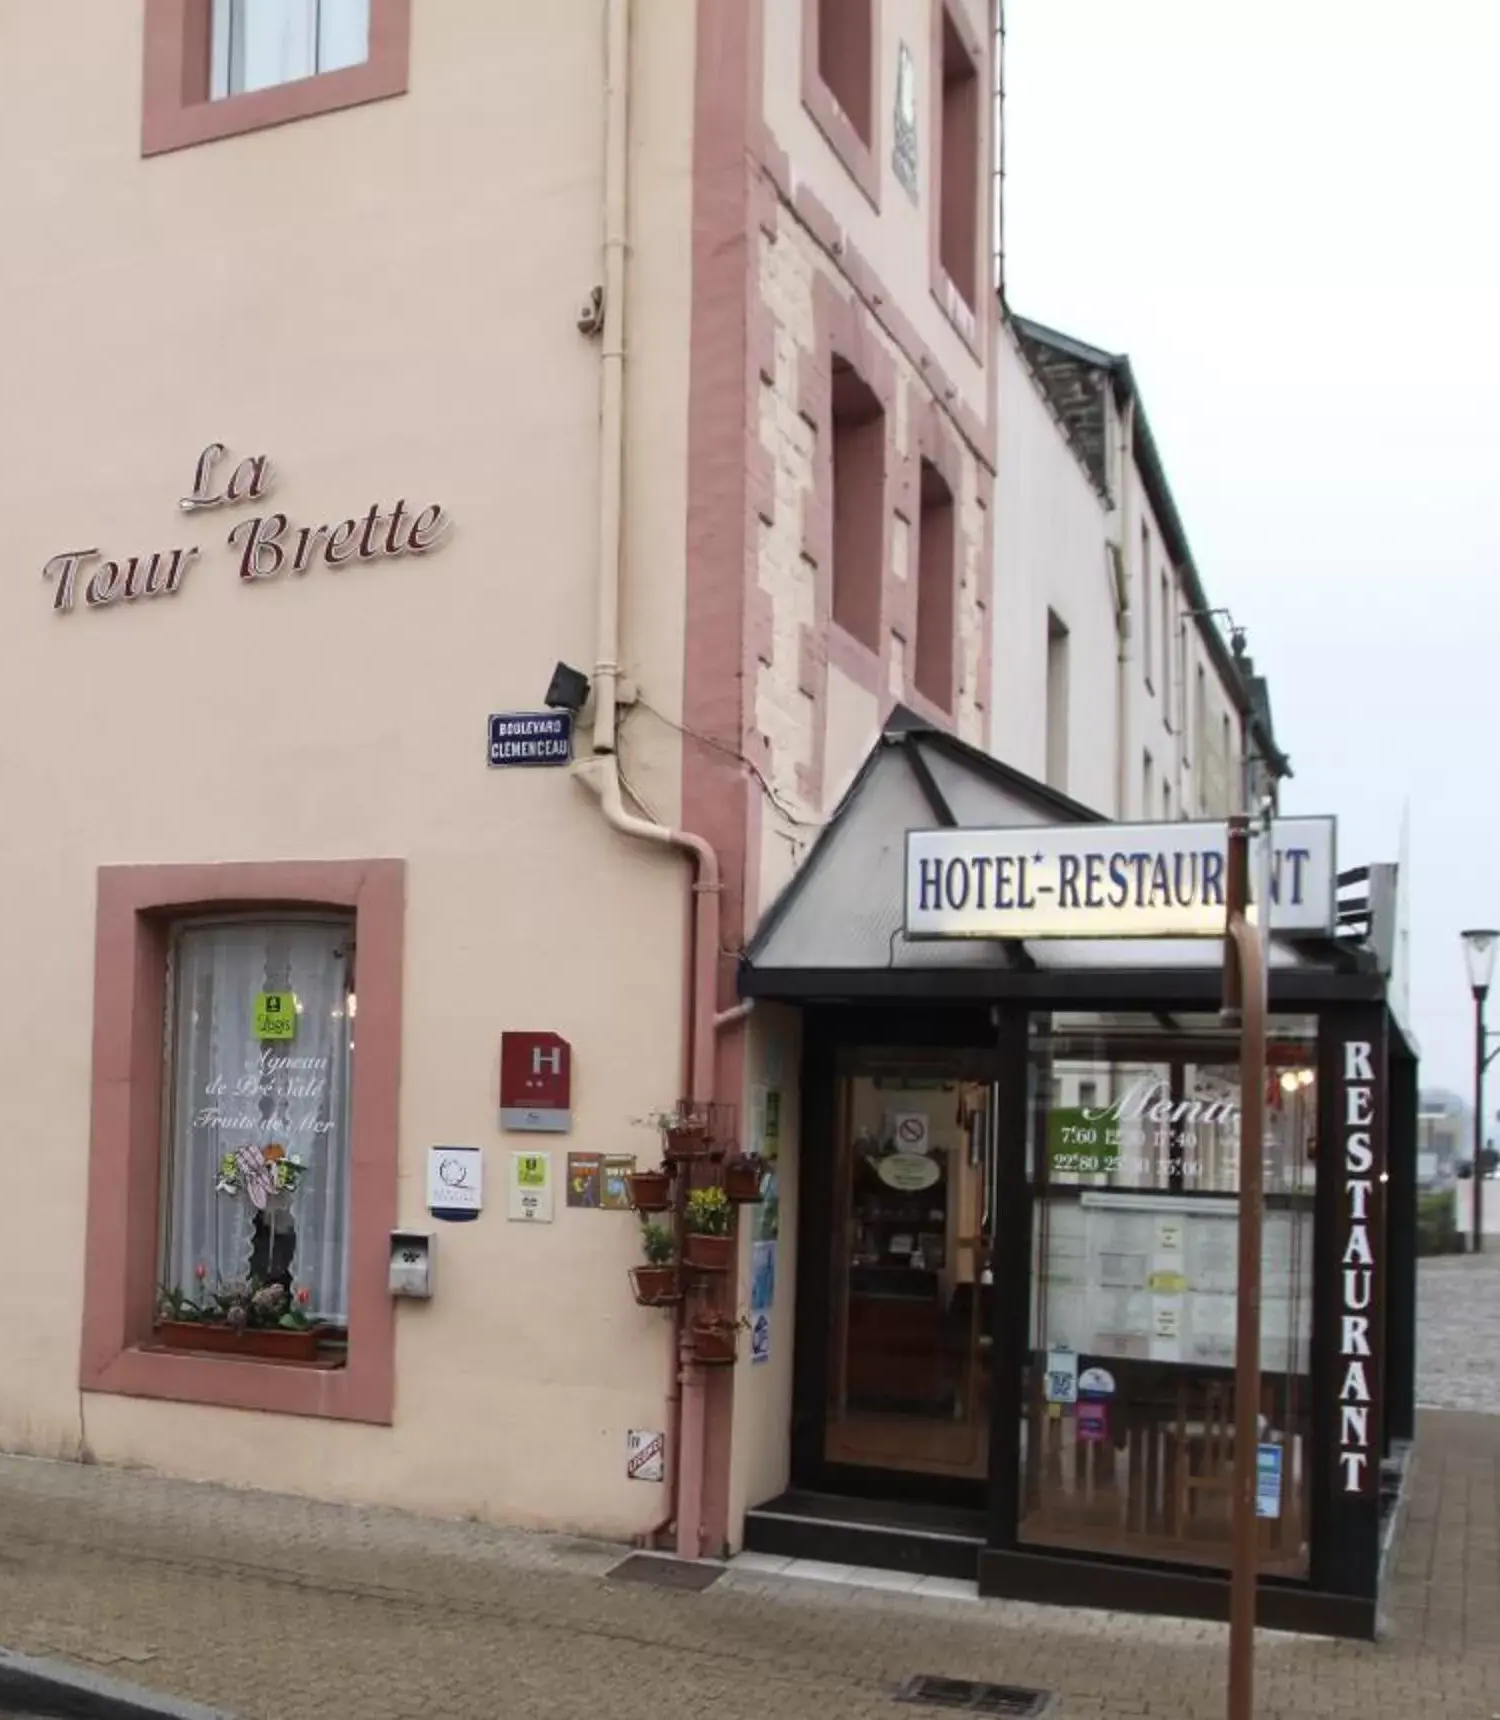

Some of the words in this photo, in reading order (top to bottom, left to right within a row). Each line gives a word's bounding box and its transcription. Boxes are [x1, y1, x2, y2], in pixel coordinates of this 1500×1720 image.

[177, 442, 272, 513] La
[42, 547, 200, 615] Tour
[227, 498, 450, 583] Brette
[499, 720, 562, 736] BOULEVARD
[491, 738, 568, 758] CLEMENCEAU
[918, 848, 1311, 911] HOTEL-RESTAURNT
[532, 1047, 561, 1075] H
[205, 1074, 227, 1096] de
[193, 1105, 255, 1130] Fruits
[1339, 1040, 1376, 1494] RESTAURANT
